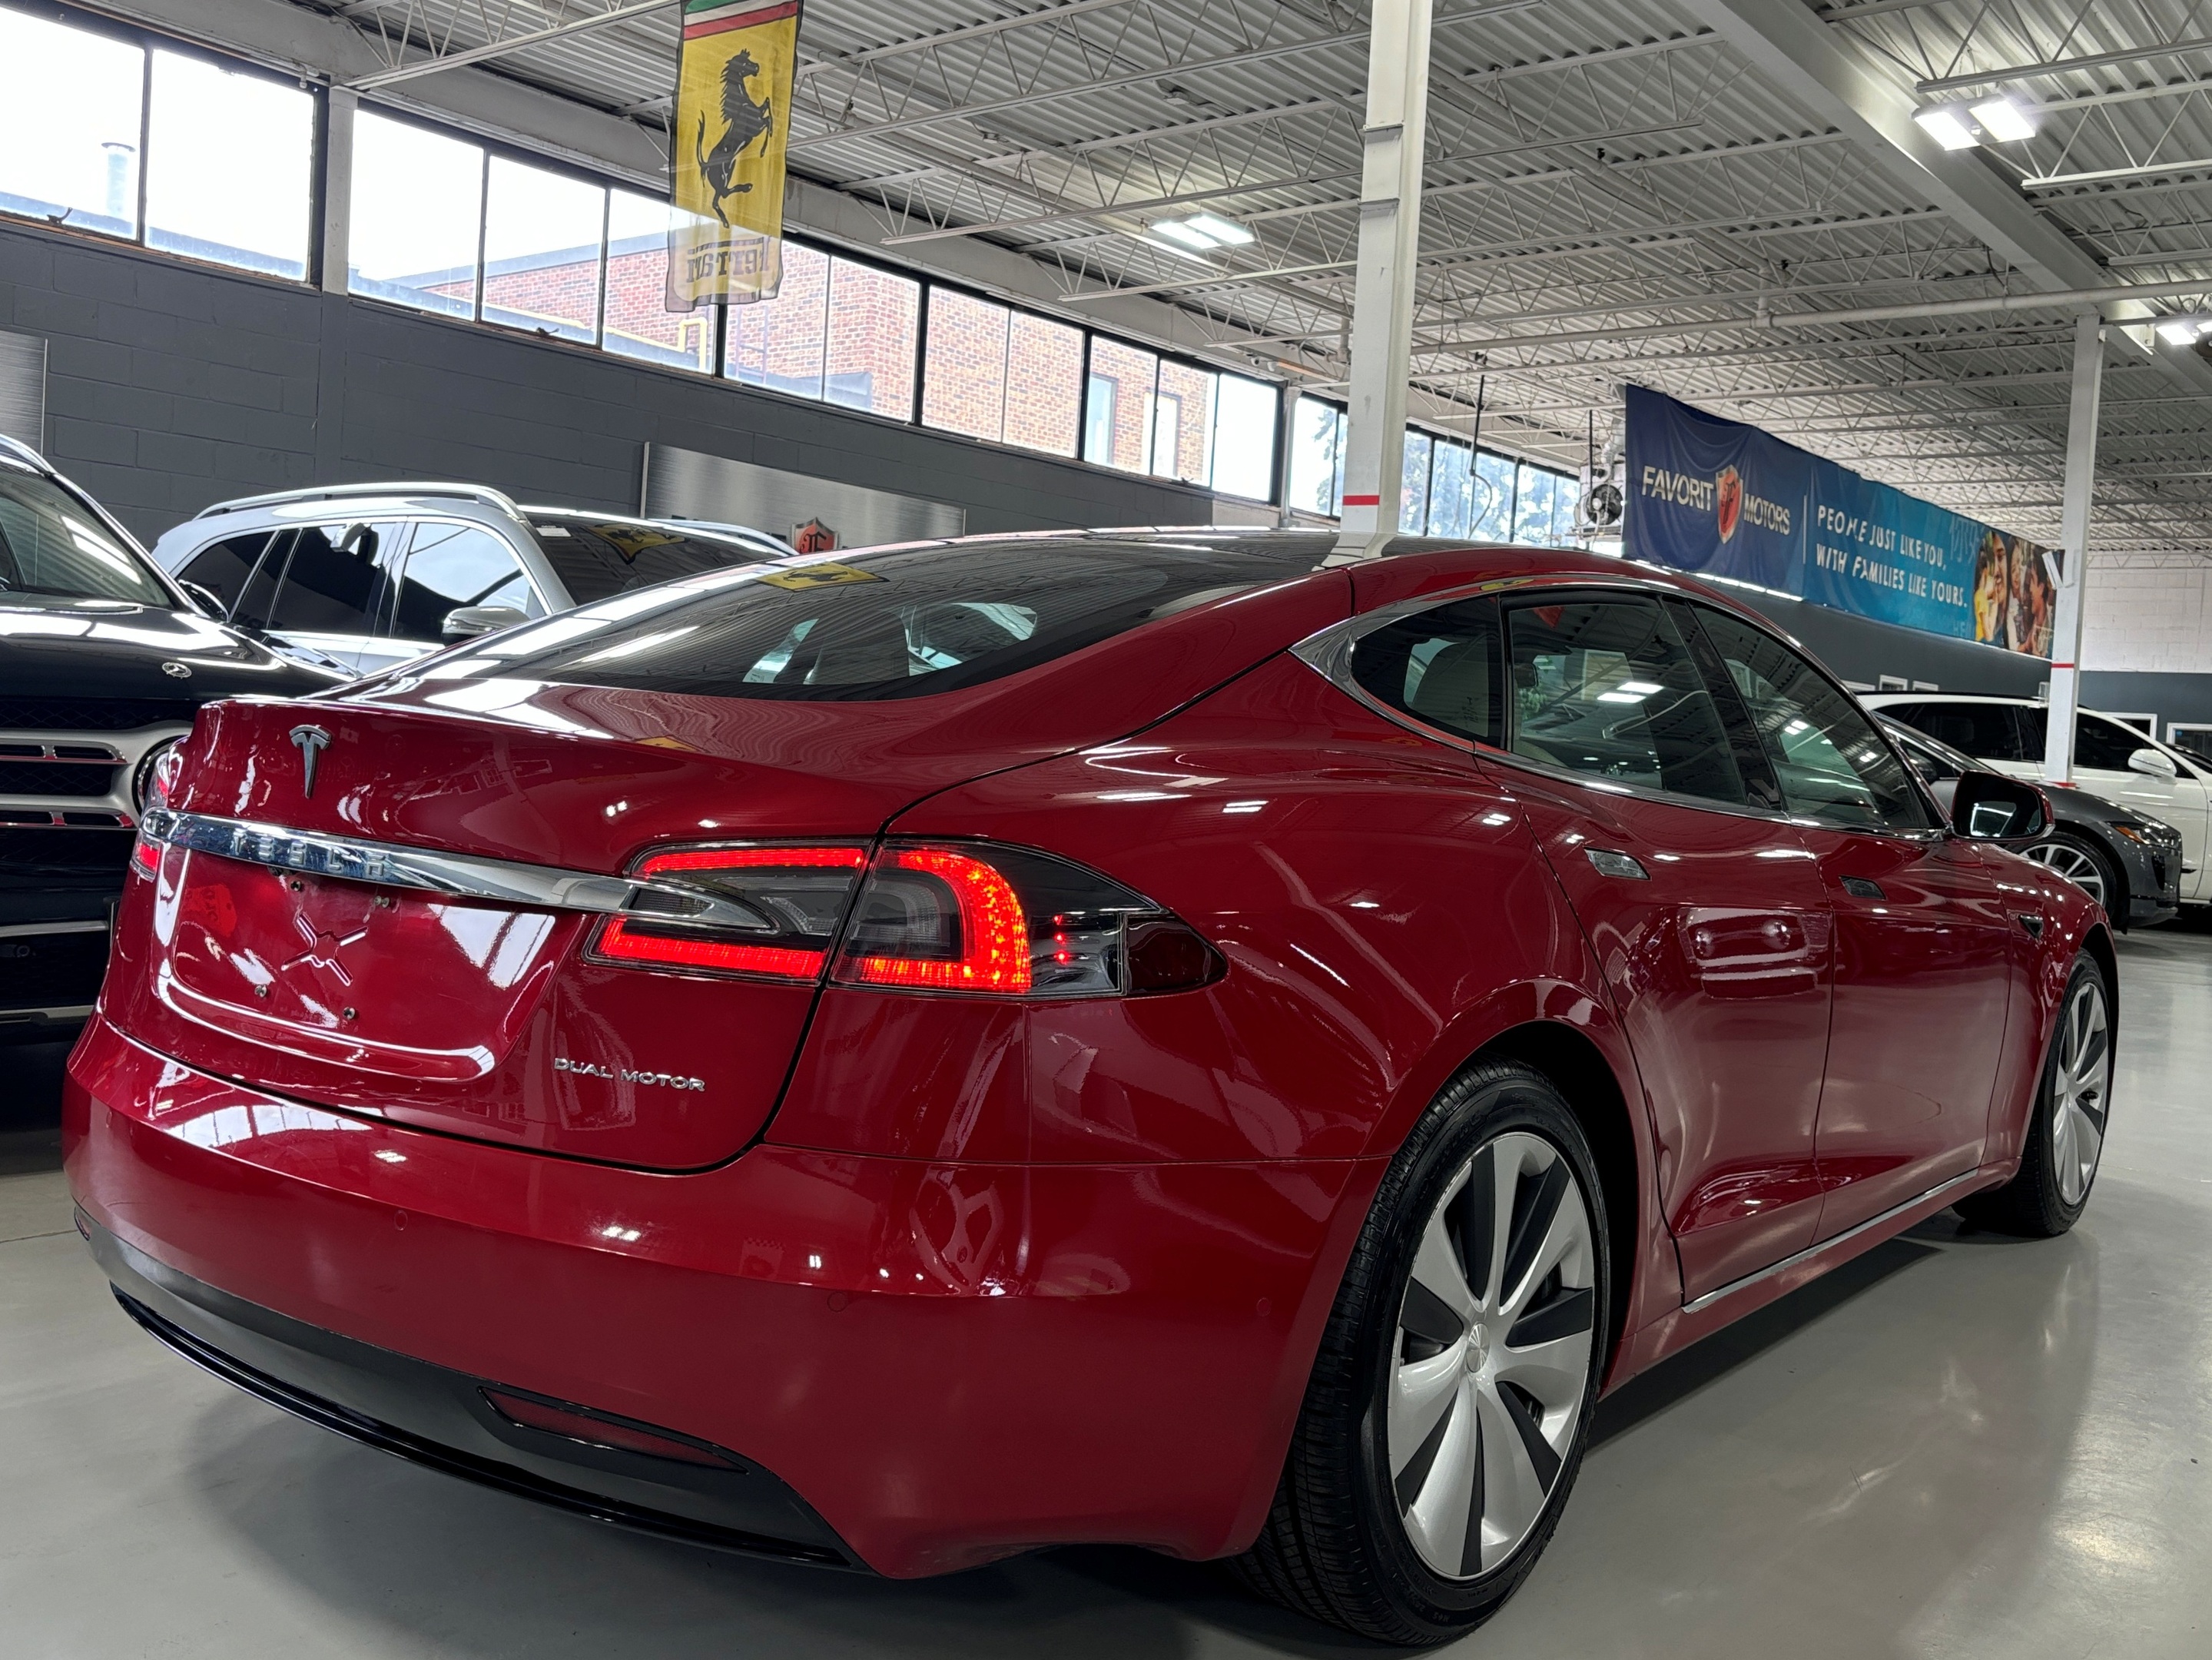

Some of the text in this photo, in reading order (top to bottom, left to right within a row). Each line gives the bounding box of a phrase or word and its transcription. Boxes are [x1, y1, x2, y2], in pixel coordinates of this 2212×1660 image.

[1641, 465, 1714, 512] FAVORIT
[1743, 493, 1791, 536] MOTORS
[1869, 524, 1896, 552] JUST
[1899, 534, 1922, 560] LIKE
[1923, 540, 1947, 572] YOU,
[1816, 543, 1968, 609] WITH FAMILIES LIKE YOURS.
[231, 827, 386, 878] TESLA
[554, 1057, 705, 1092] DUAL MOTOR
